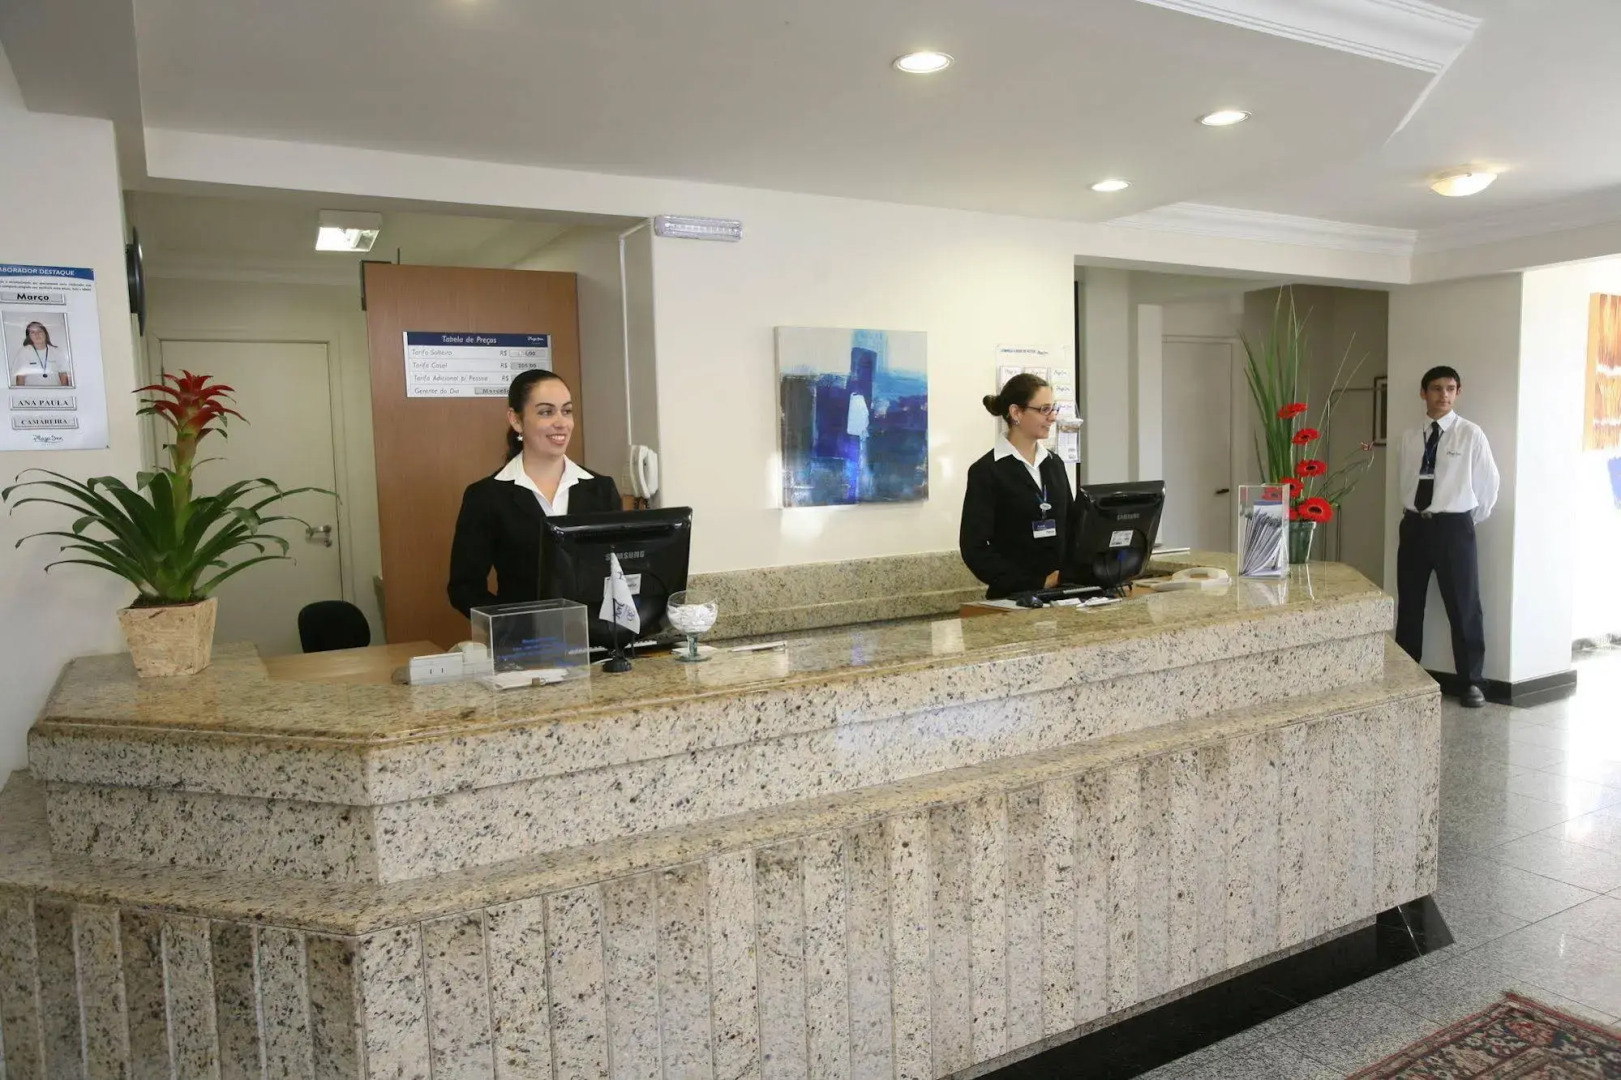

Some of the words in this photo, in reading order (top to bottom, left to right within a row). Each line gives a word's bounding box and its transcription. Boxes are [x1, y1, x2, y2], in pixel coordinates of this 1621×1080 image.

[39, 268, 75, 276] DESTAQUE
[16, 293, 50, 302] Março
[442, 335, 464, 343] Tabela
[476, 336, 497, 346] Preços
[605, 550, 645, 561] SMSUNG
